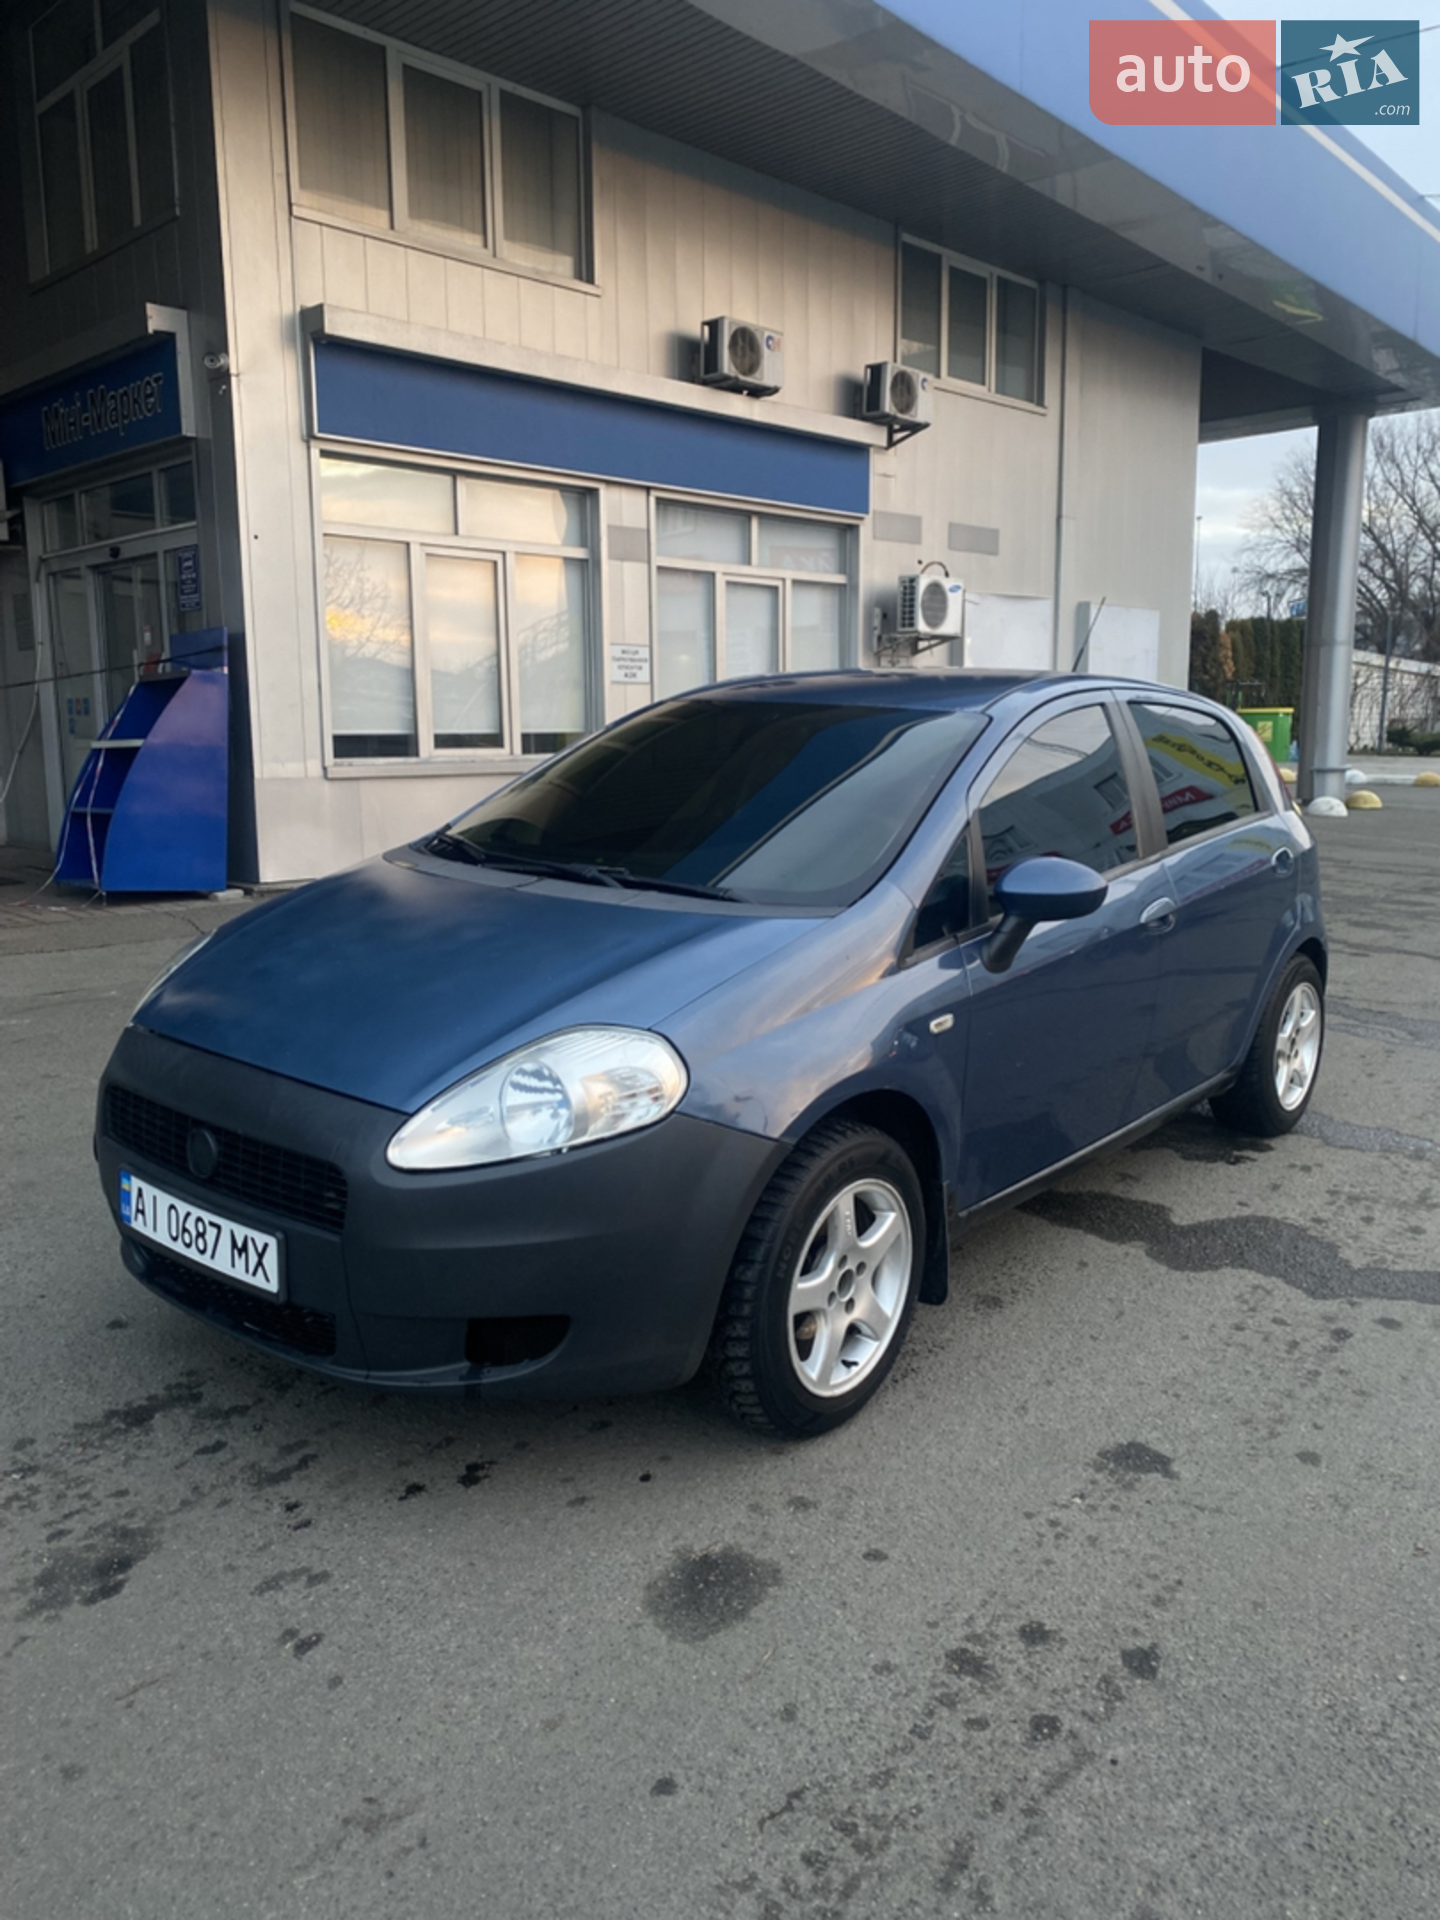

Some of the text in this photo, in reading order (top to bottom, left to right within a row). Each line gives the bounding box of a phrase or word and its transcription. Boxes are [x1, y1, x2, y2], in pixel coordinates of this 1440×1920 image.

[42, 372, 163, 450] Міні-Маркет
[134, 1186, 271, 1283] AI 0687 MX
